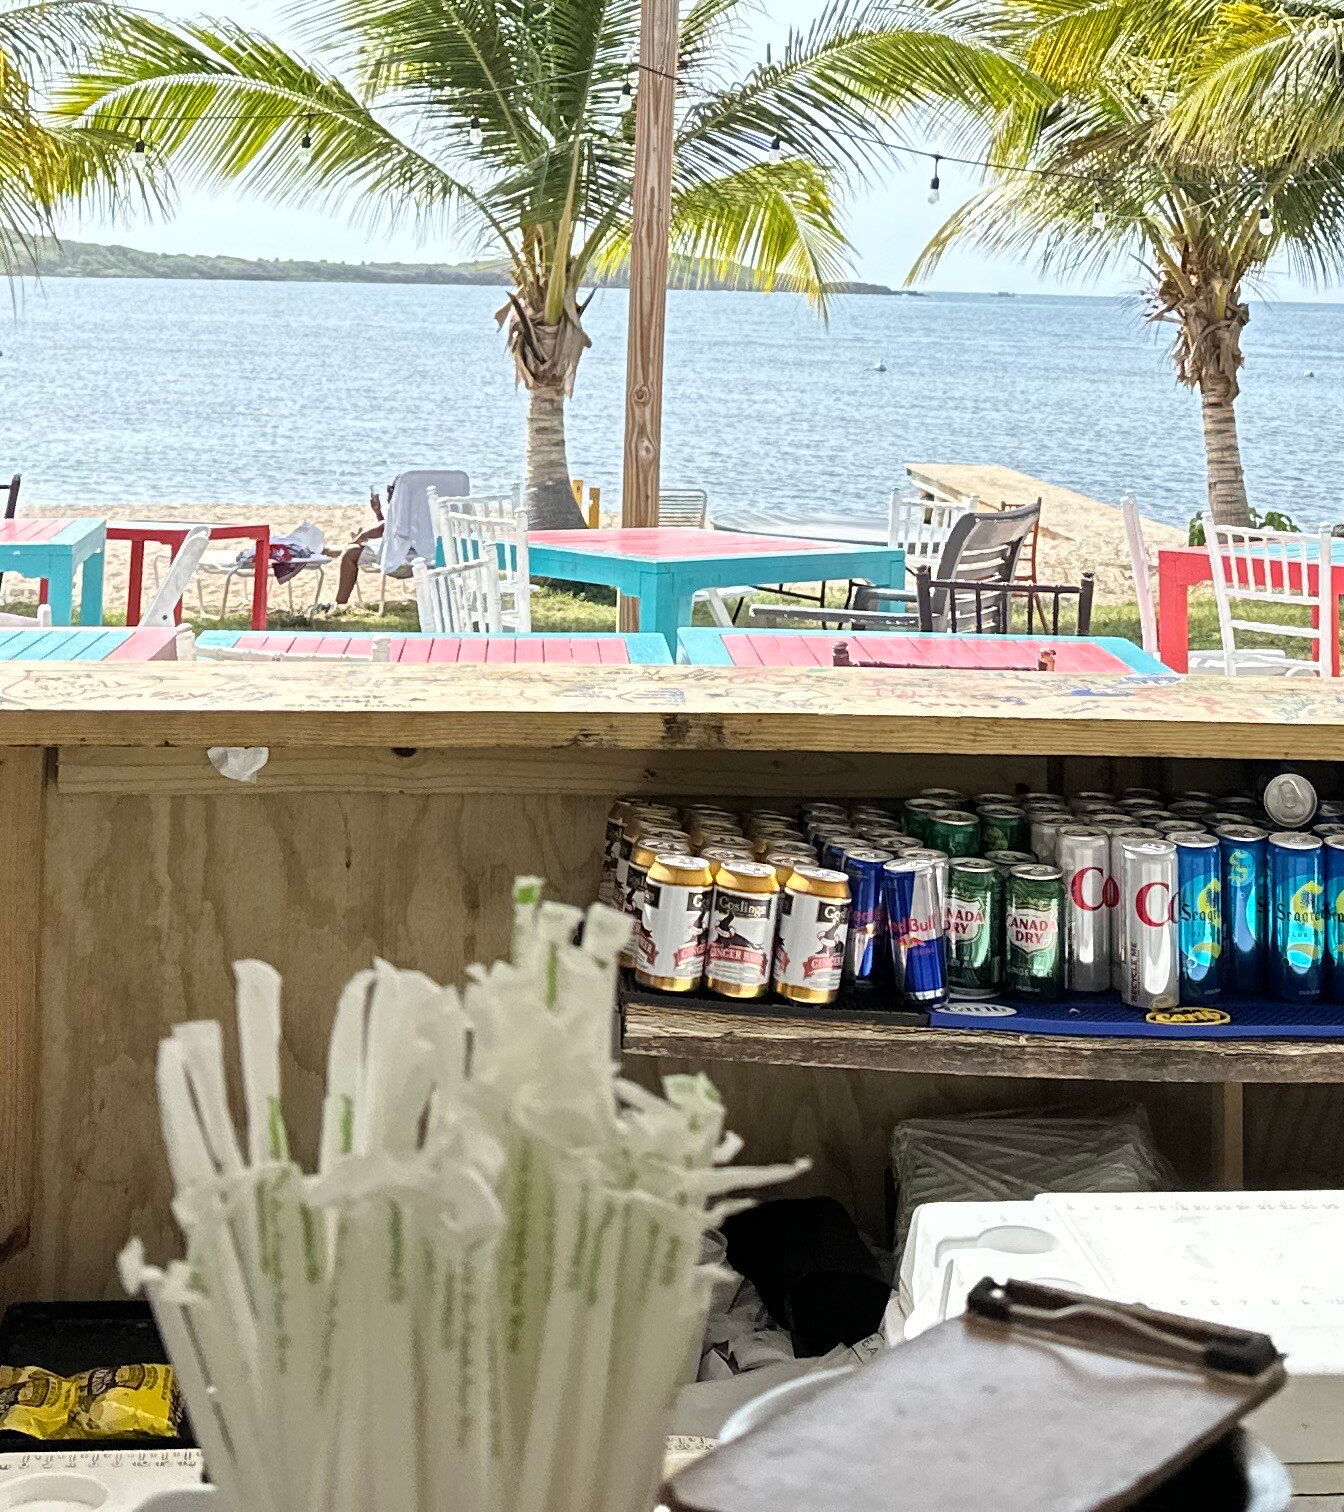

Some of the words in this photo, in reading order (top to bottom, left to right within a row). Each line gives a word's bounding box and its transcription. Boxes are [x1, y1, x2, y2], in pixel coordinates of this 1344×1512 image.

[718, 894, 766, 918] Goslings
[1005, 913, 1057, 933] CANADA
[1015, 929, 1042, 944] DRY
